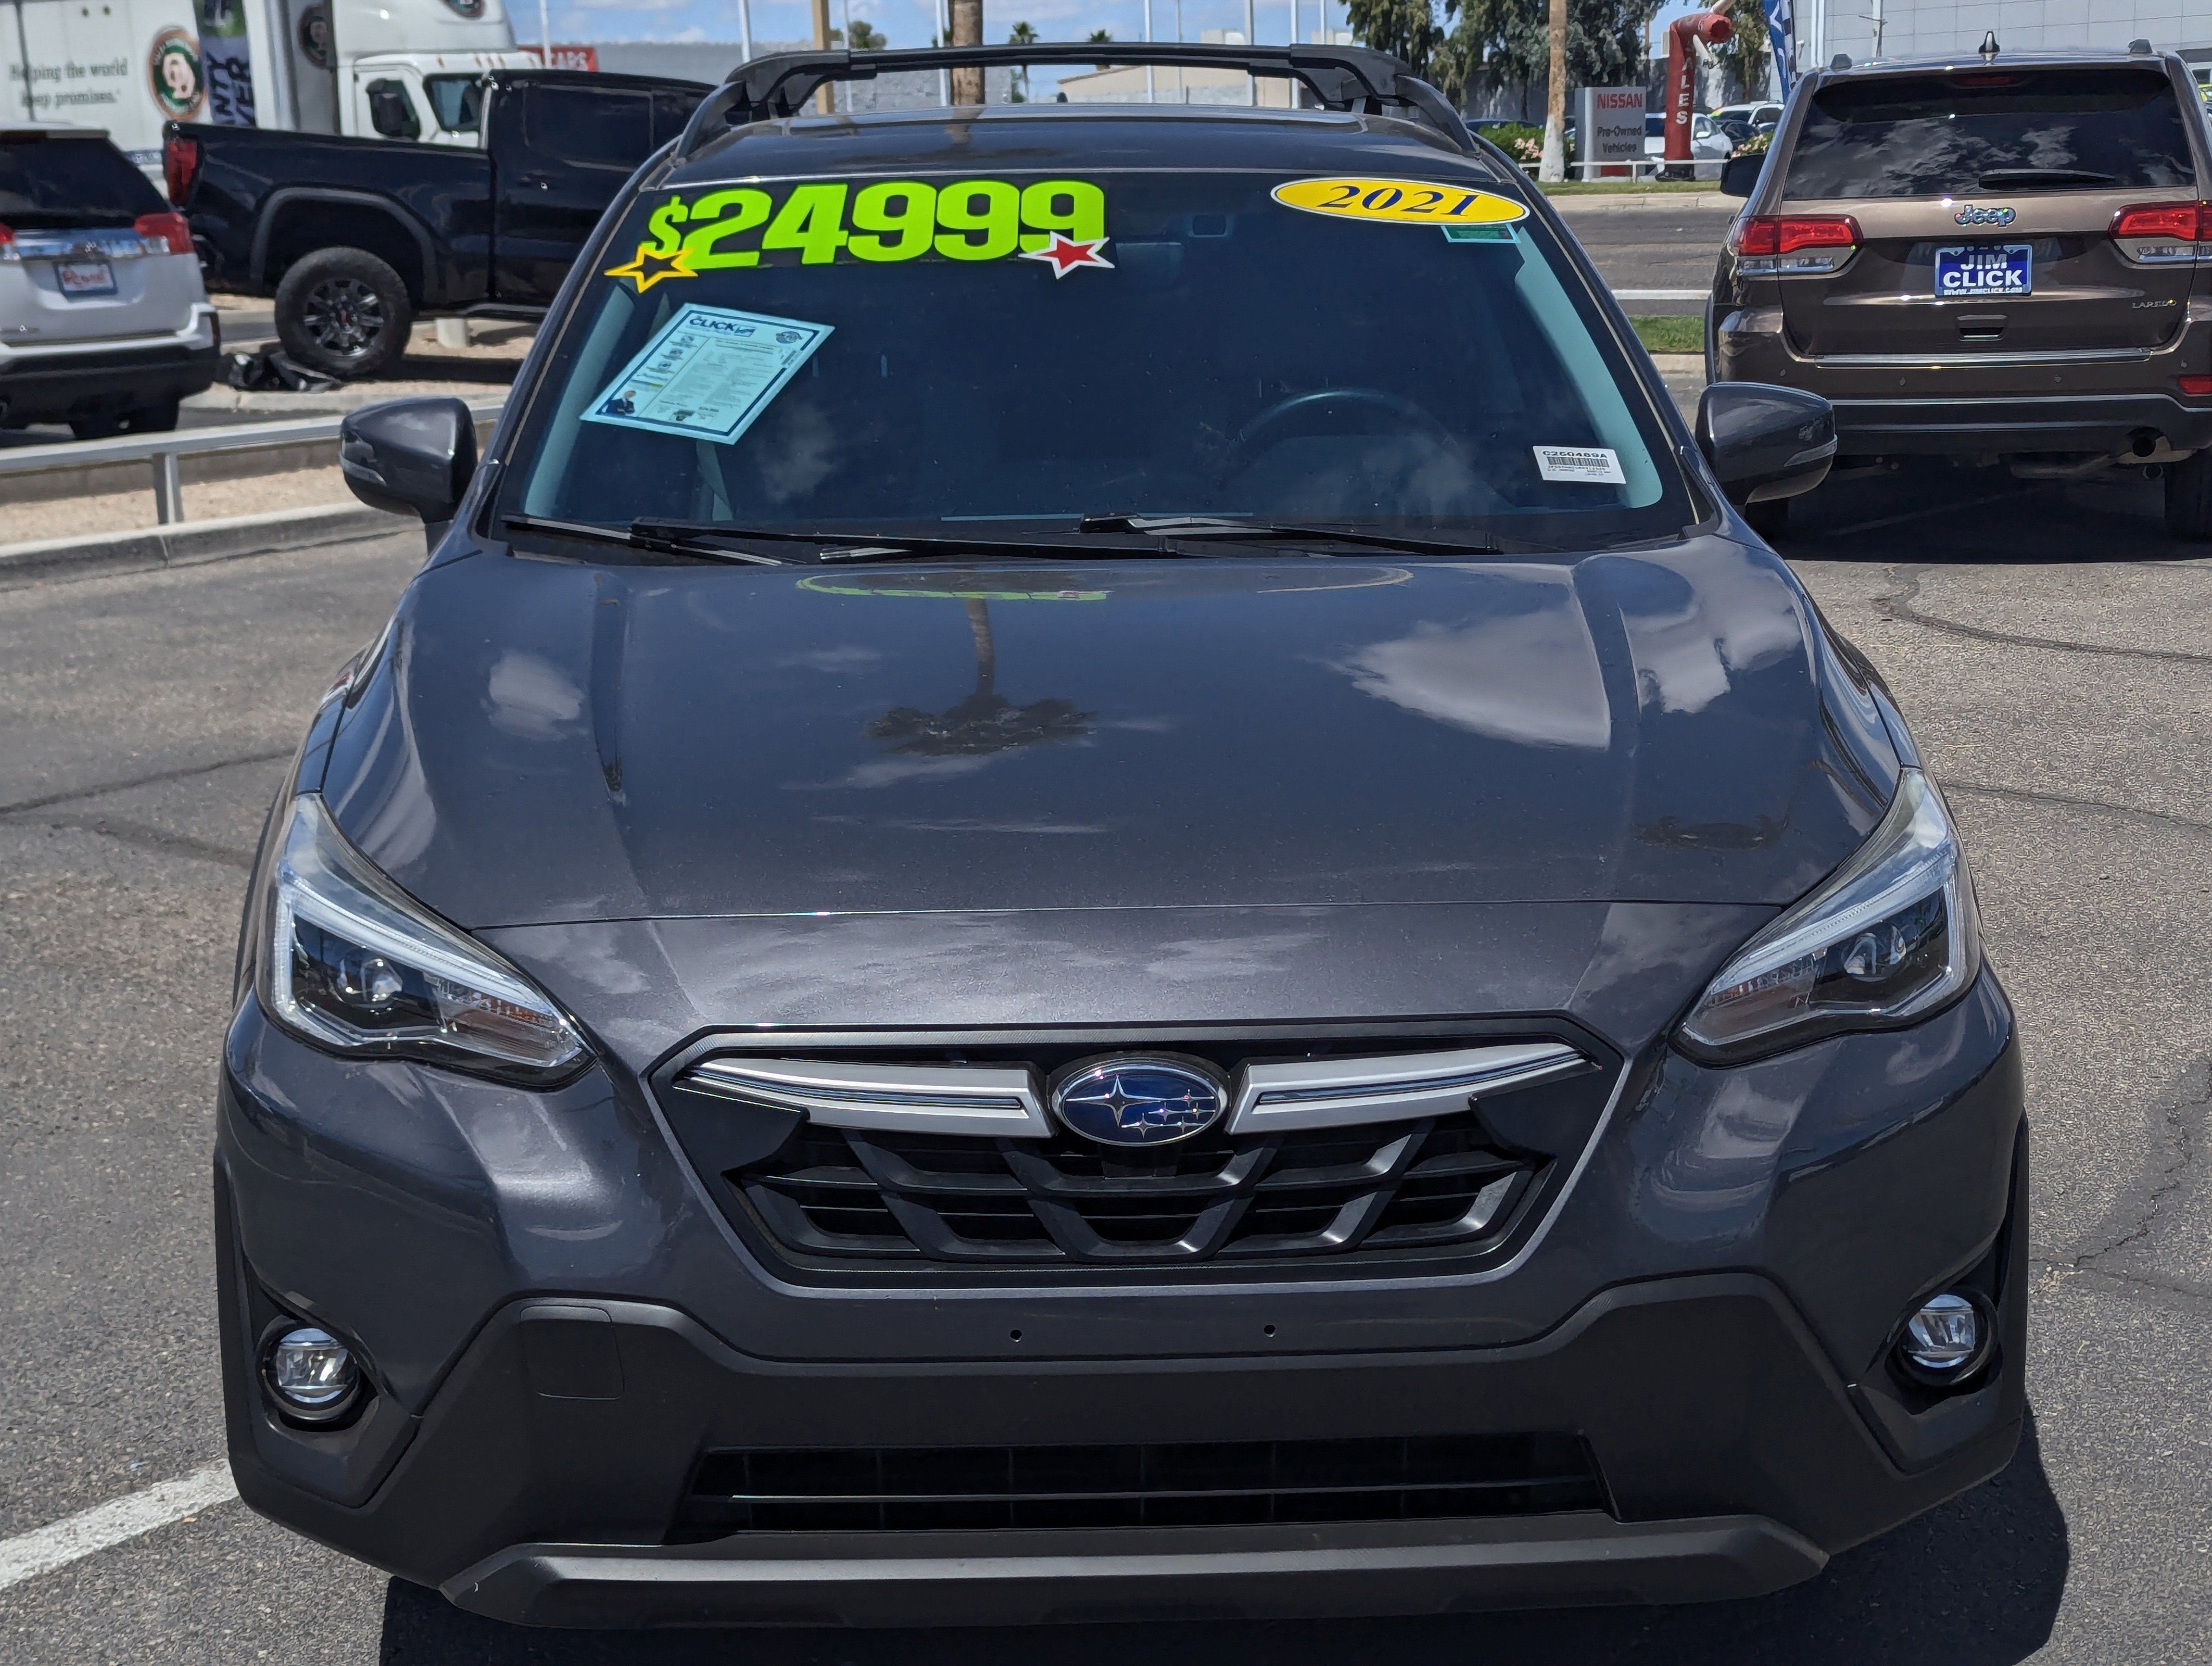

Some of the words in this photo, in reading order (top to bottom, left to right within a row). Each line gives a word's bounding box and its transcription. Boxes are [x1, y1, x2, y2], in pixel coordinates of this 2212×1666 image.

[1597, 93, 1643, 108] NISSAN
[1597, 125, 1642, 137] Pre-Owned
[1602, 142, 1637, 153] Vehicles
[1316, 185, 1480, 216] 2021
[1954, 204, 2016, 227] Jeep
[642, 180, 1105, 270] $24999
[1960, 254, 2008, 270] JIM
[1943, 270, 2023, 287] CLICK
[690, 317, 737, 331] CLICK
